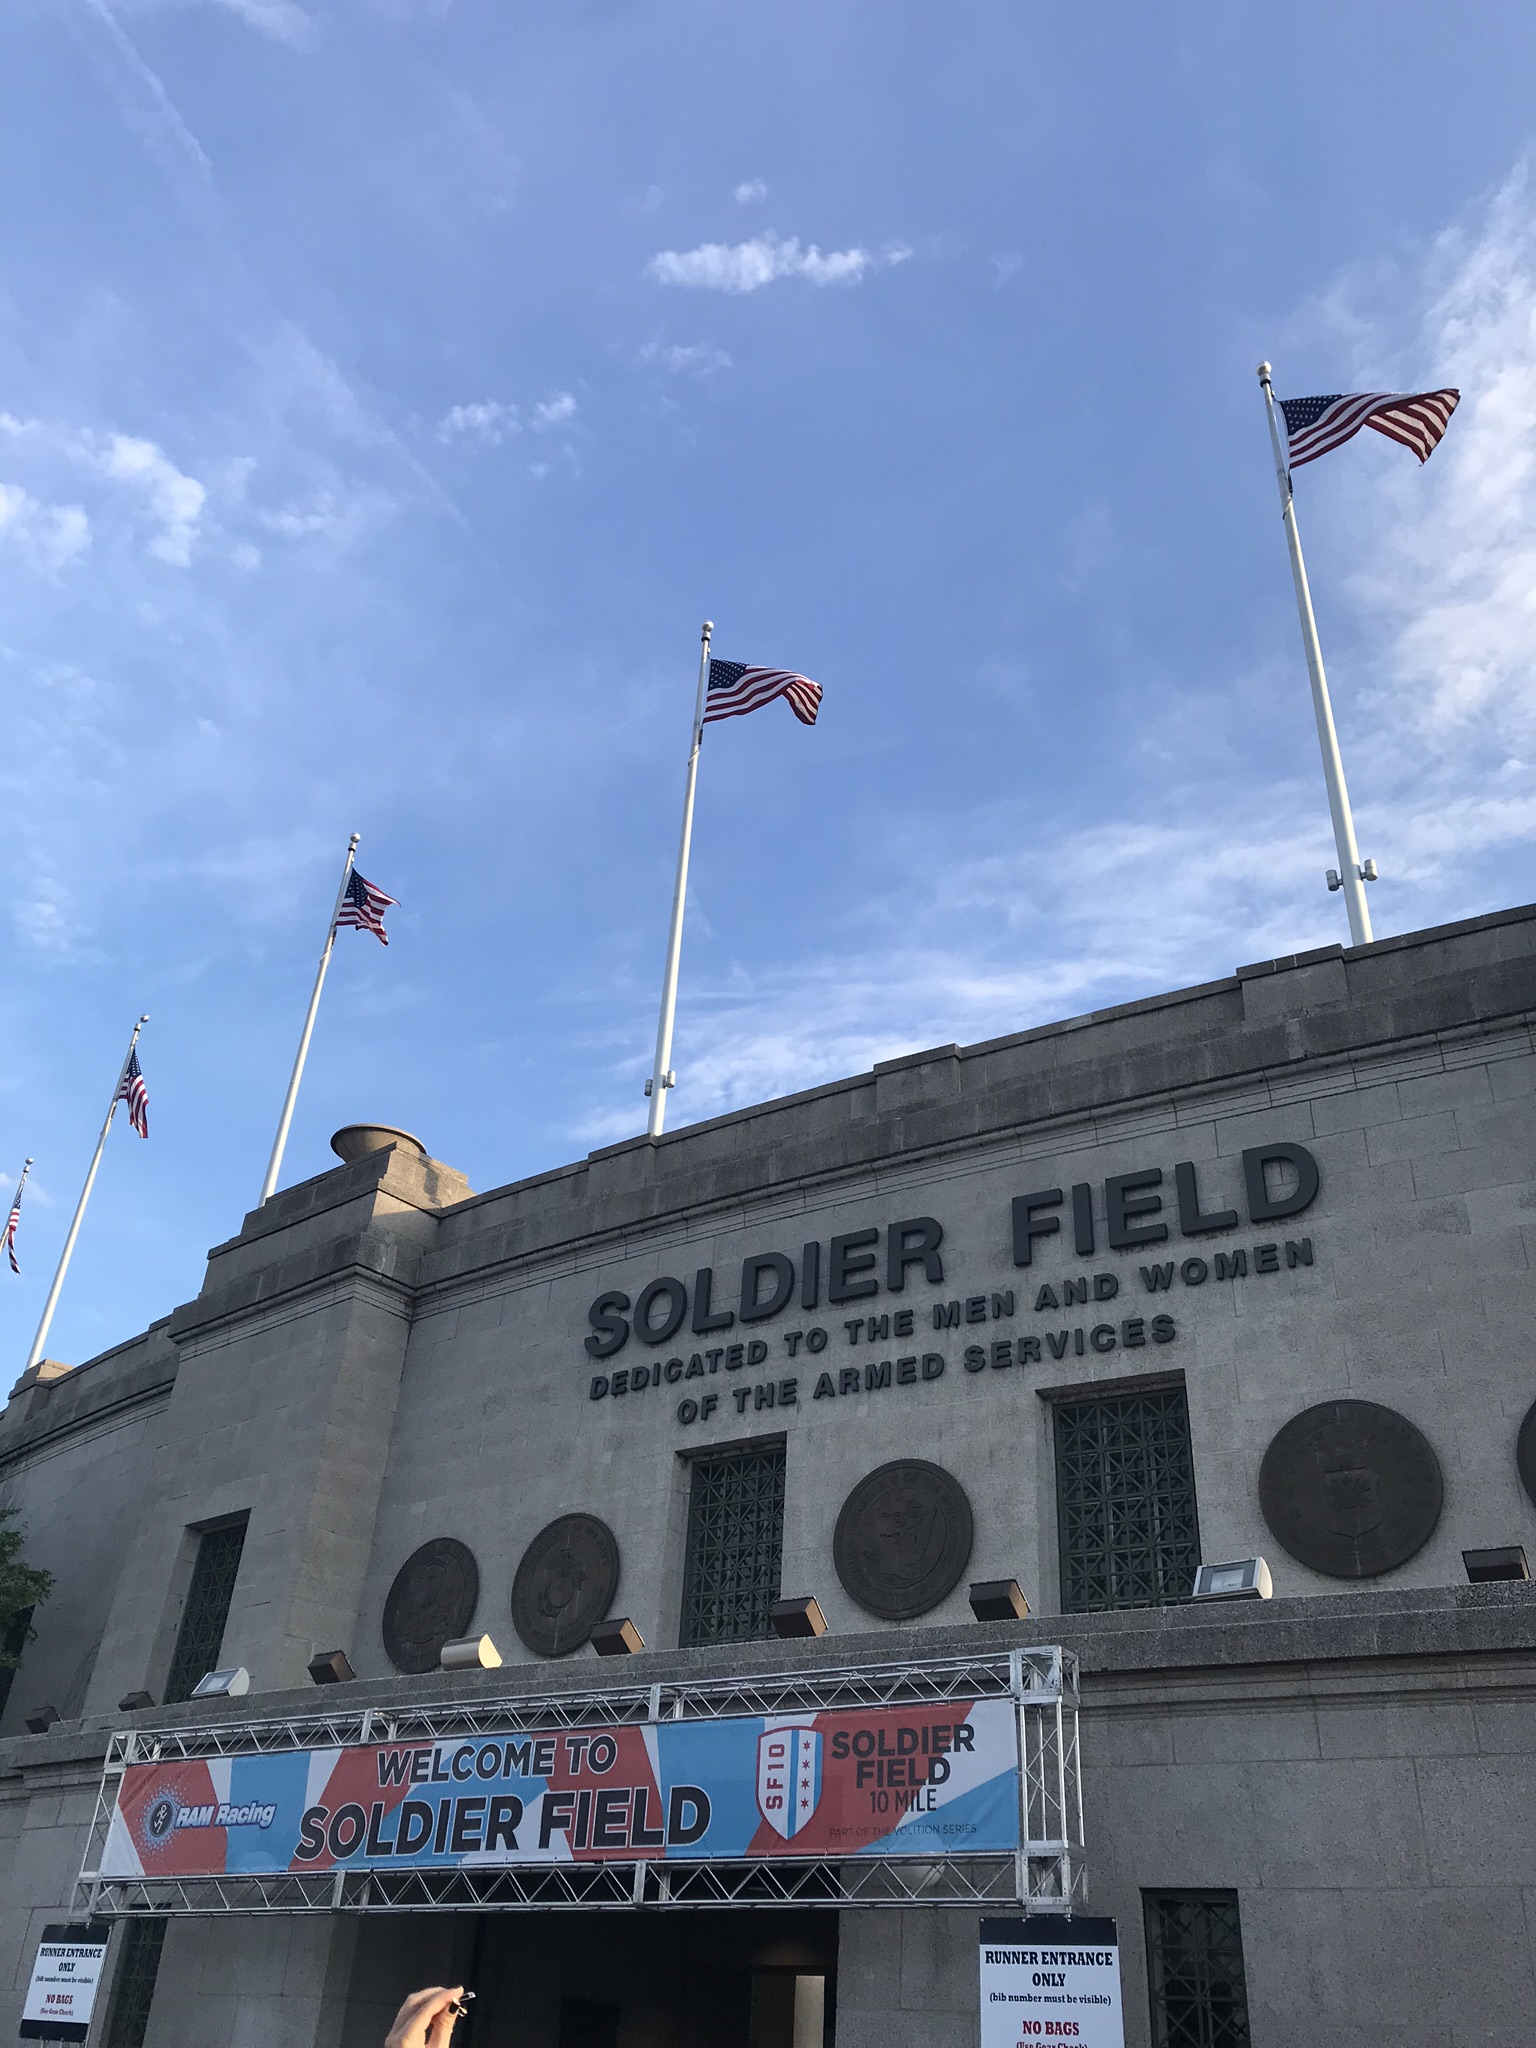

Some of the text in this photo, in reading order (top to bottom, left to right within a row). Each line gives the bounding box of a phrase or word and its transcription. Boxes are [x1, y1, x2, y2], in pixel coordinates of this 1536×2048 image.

[584, 1142, 1320, 1358] SOLDIER FIELD
[589, 1238, 1314, 1400] DEDICATED TO THE MEN AND WOMEN
[677, 1314, 1177, 1425] OF THE ARMED SERVICES
[831, 1723, 976, 1760] SOLDIER
[377, 1733, 618, 1787] WELCOME TO
[856, 1756, 951, 1789] FIELD
[766, 1743, 785, 1810] SF10
[175, 1800, 278, 1830] RAM Racing
[869, 1788, 937, 1814] 10 MILE
[295, 1784, 712, 1861] SOLDIER FIELD
[829, 1823, 977, 1838] PART OF THE VOLITION SERIES
[40, 1948, 102, 1958] RUNNER ENTRANCE
[58, 1962, 76, 1972] ONLY
[985, 1950, 1113, 1966] RUNNER ENTRANCE
[1032, 1972, 1066, 1987] ONLY
[45, 1994, 74, 2005] NO BAGS
[989, 1992, 1112, 2007] (bib number must be visible)
[1022, 2020, 1080, 2036] NO BAGS
